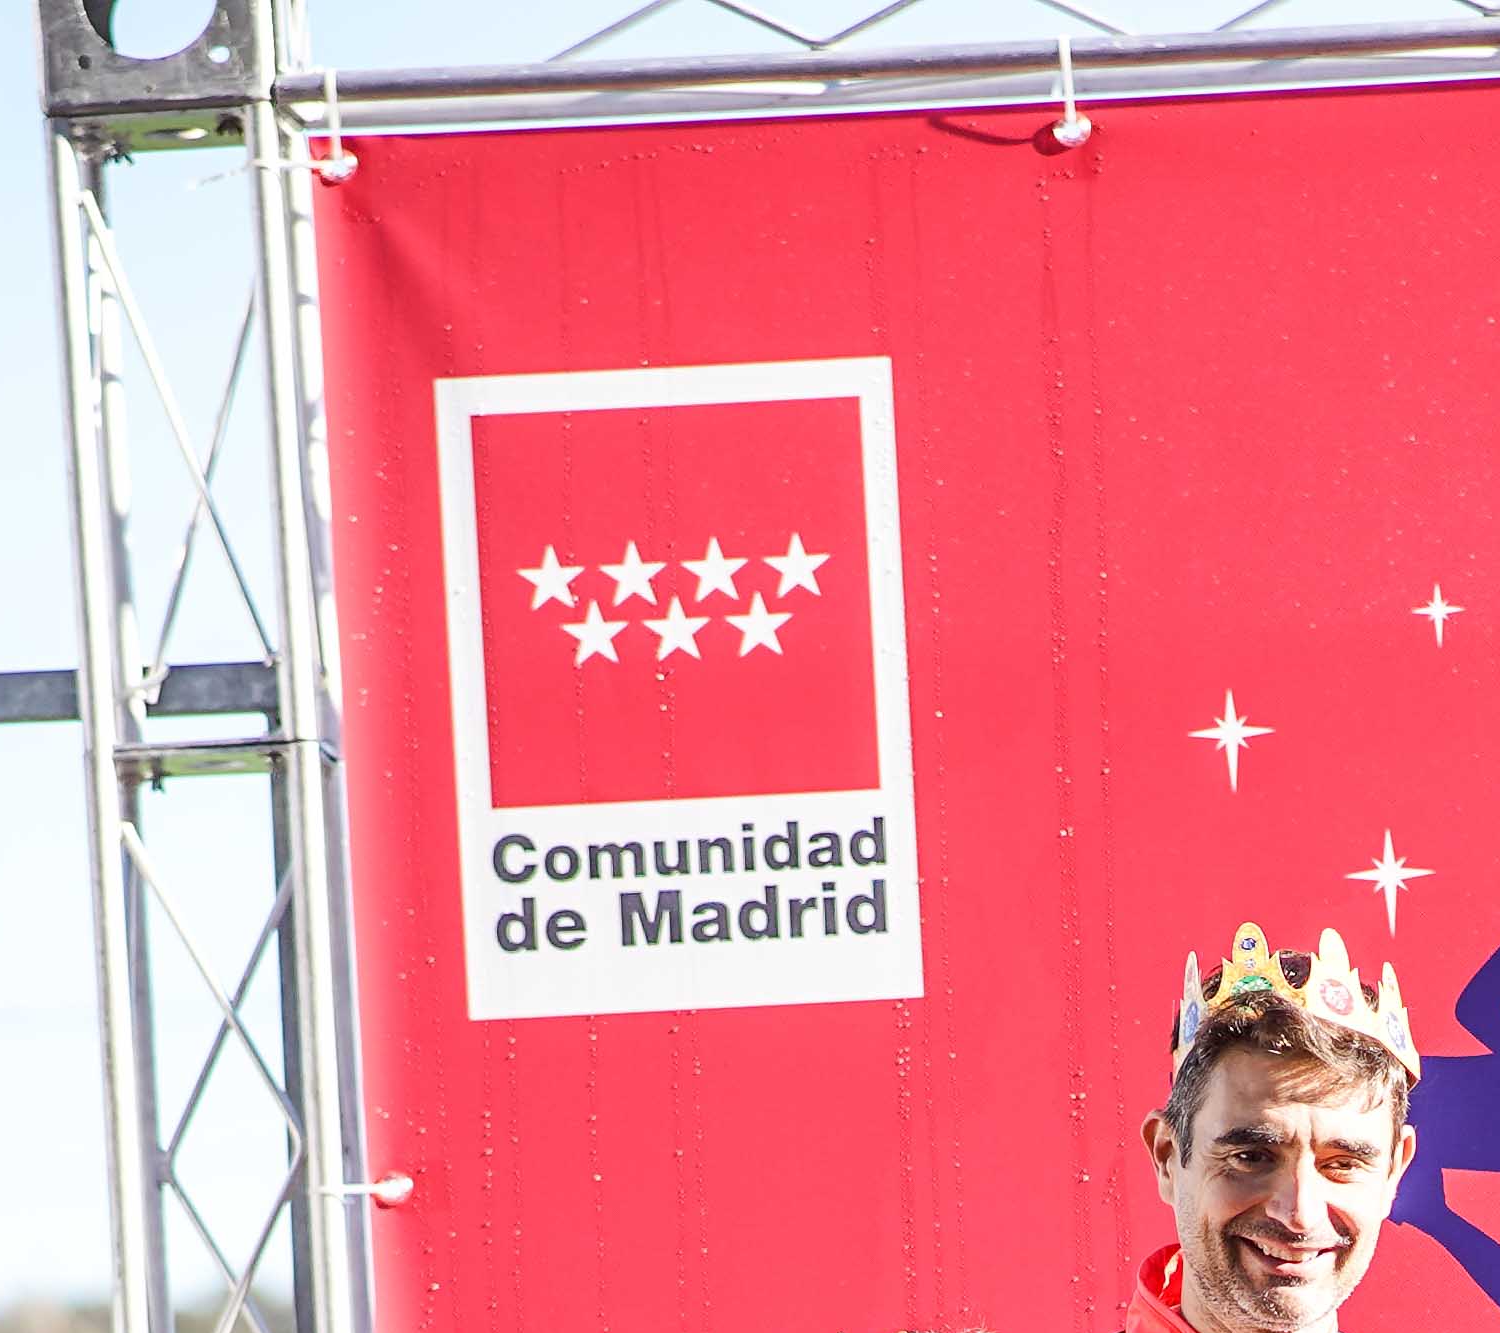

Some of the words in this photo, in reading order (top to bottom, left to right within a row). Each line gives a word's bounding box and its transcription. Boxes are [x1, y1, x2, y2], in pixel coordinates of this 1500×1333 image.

[492, 816, 887, 883] Comunidad
[495, 897, 587, 953] de
[619, 879, 889, 947] Madrid
